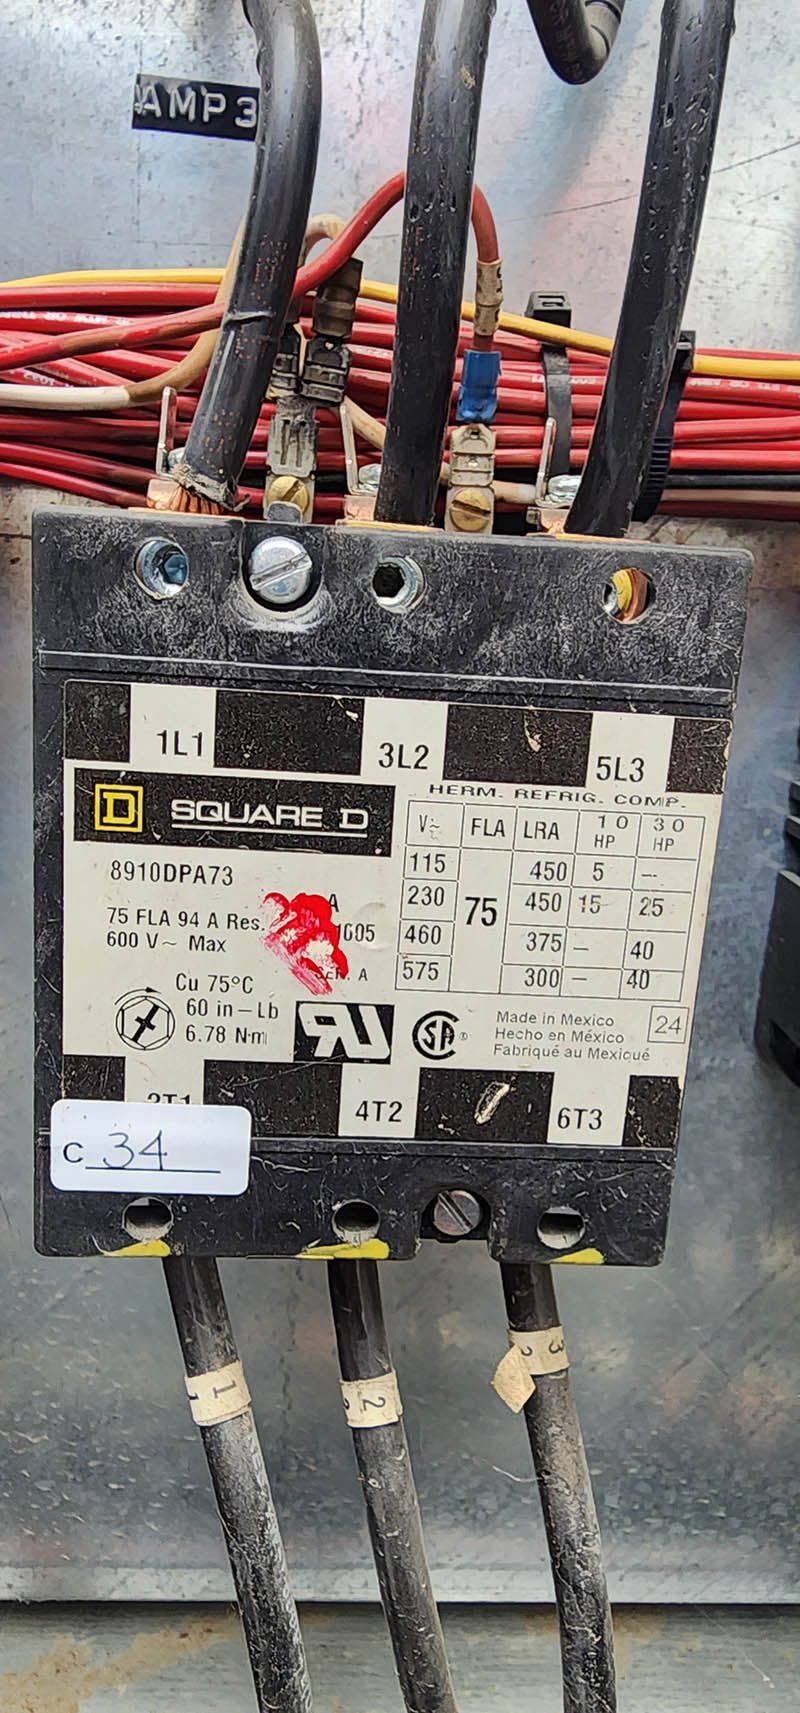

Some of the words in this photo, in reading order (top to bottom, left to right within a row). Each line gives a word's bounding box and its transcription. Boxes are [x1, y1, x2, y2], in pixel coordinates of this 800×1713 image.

[157, 730, 203, 757] 1L1
[379, 742, 429, 770] 3L2
[597, 756, 645, 783] 5L3
[429, 784, 504, 798] HERM.
[515, 788, 604, 804] REFRIG.
[614, 793, 686, 808] COMP.
[101, 790, 137, 825] D
[171, 799, 323, 828] SQUARE
[340, 808, 369, 830] D
[471, 817, 506, 838] FLA
[523, 820, 560, 841] LRA
[594, 834, 616, 849] HP
[653, 836, 675, 852] HP
[110, 860, 234, 887] 8910DPA73
[409, 853, 446, 874] 115
[529, 861, 568, 882] 450
[592, 862, 605, 882] 5
[407, 886, 445, 907] 230
[525, 892, 562, 913] 450
[579, 894, 602, 914] 15
[639, 896, 665, 918] 25
[107, 907, 129, 926] 75
[137, 908, 171, 927] FLA
[178, 911, 200, 928] 94
[207, 912, 219, 929] A
[227, 913, 266, 932] Res.
[465, 896, 498, 928] 75
[106, 931, 139, 949] 600
[189, 935, 227, 953] Max
[404, 925, 442, 945] 460
[526, 931, 563, 952] 375
[630, 940, 654, 960] 40
[402, 961, 440, 981] 575
[523, 968, 561, 988] 300
[626, 968, 651, 990] 40
[175, 973, 199, 991] Cu
[186, 998, 208, 1017] 60
[496, 1010, 537, 1025] Made
[541, 1011, 555, 1025] in
[560, 1013, 615, 1027] Mexico
[654, 1015, 682, 1035] 24
[185, 1025, 226, 1044] 6.78
[495, 1026, 543, 1041] Hecho
[549, 1031, 566, 1041] en
[571, 1029, 625, 1044] México
[493, 1044, 560, 1061] Fabriqué
[564, 1048, 582, 1059] au
[355, 1100, 403, 1123] 4T2
[557, 1107, 603, 1131] 6T3
[103, 1129, 168, 1171] 34
